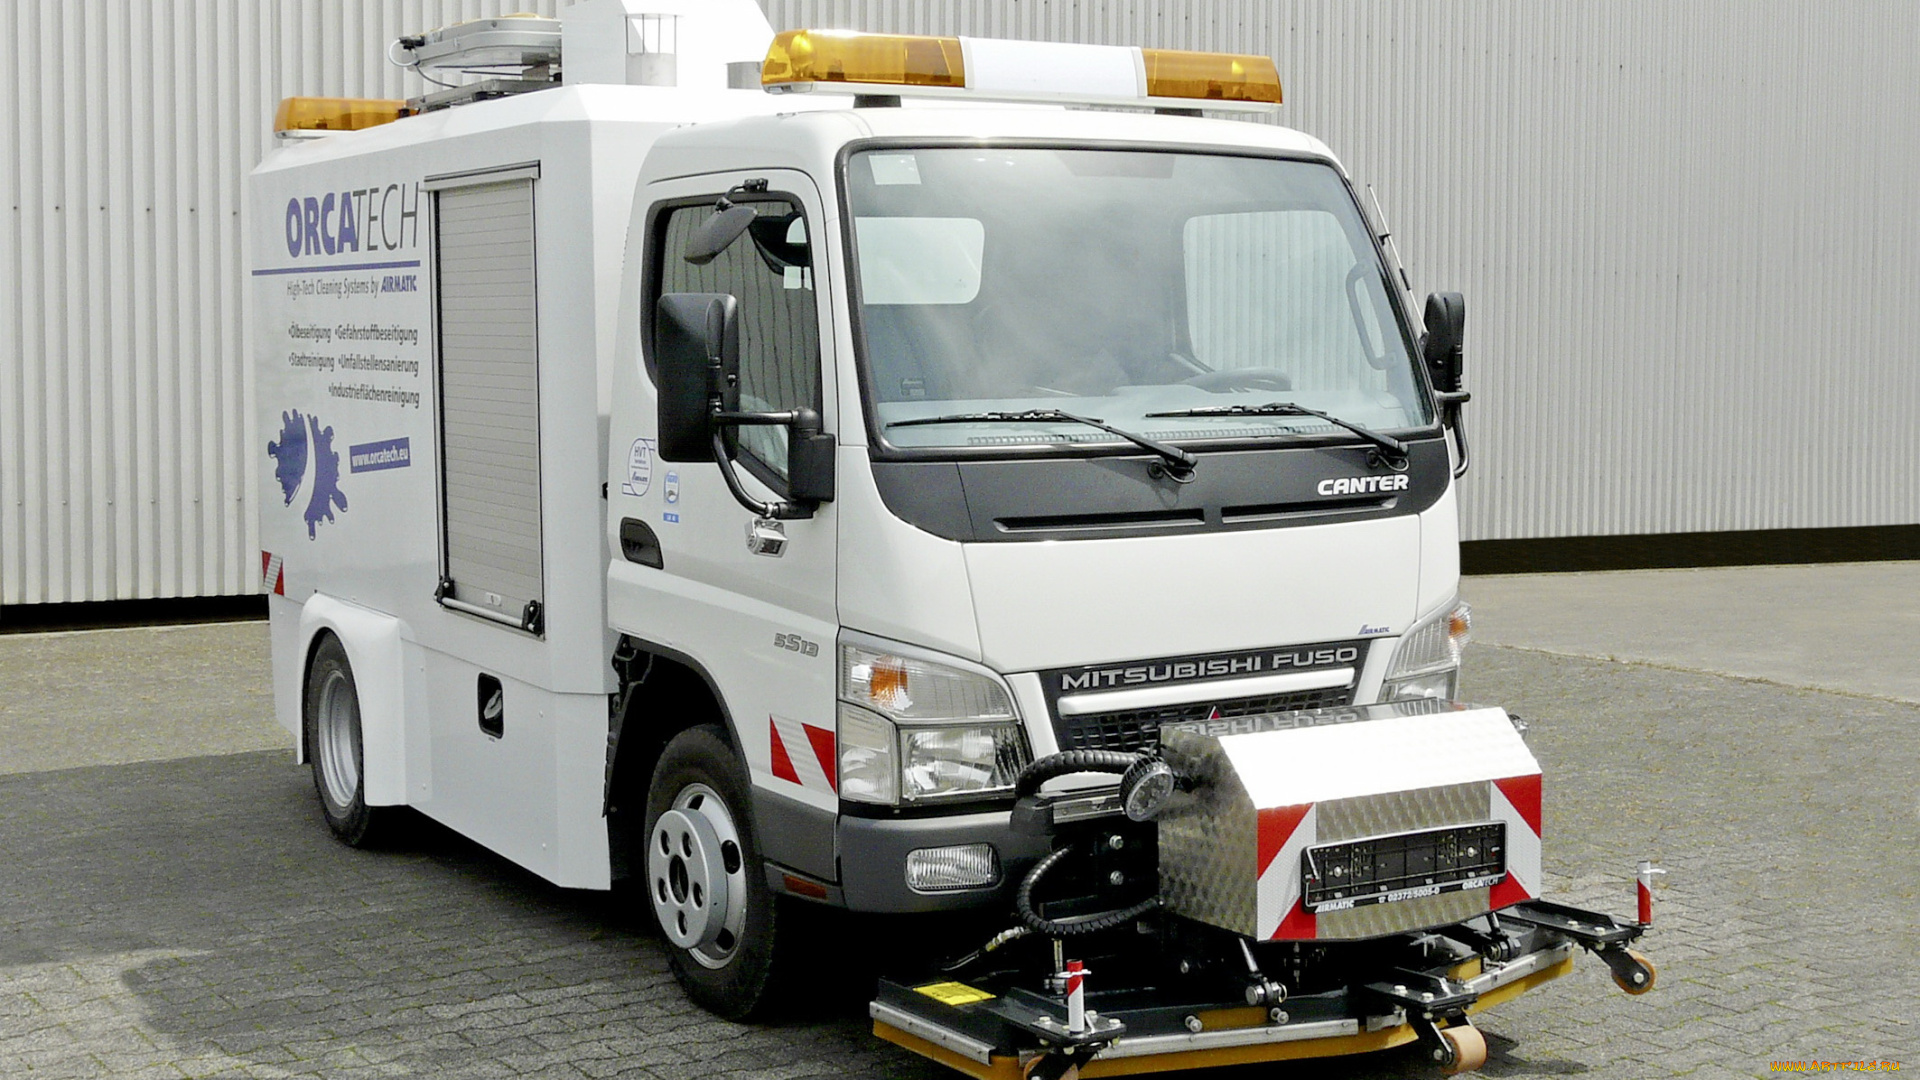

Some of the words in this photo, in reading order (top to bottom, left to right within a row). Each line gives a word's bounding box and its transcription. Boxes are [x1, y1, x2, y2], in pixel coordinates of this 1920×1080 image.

[286, 181, 419, 258] ORCATECH
[287, 279, 315, 301] High-Tech
[316, 278, 342, 300] Cleaning
[343, 277, 369, 299] Systems
[370, 275, 380, 298] by
[381, 275, 417, 293] AIRMATIC
[351, 444, 409, 467] www.orcatech.eu
[1317, 474, 1409, 496] CANTER
[1061, 656, 1262, 690] MITSUBISHI
[1272, 646, 1359, 670] FUSO
[1314, 900, 1355, 914] AIRMATIC
